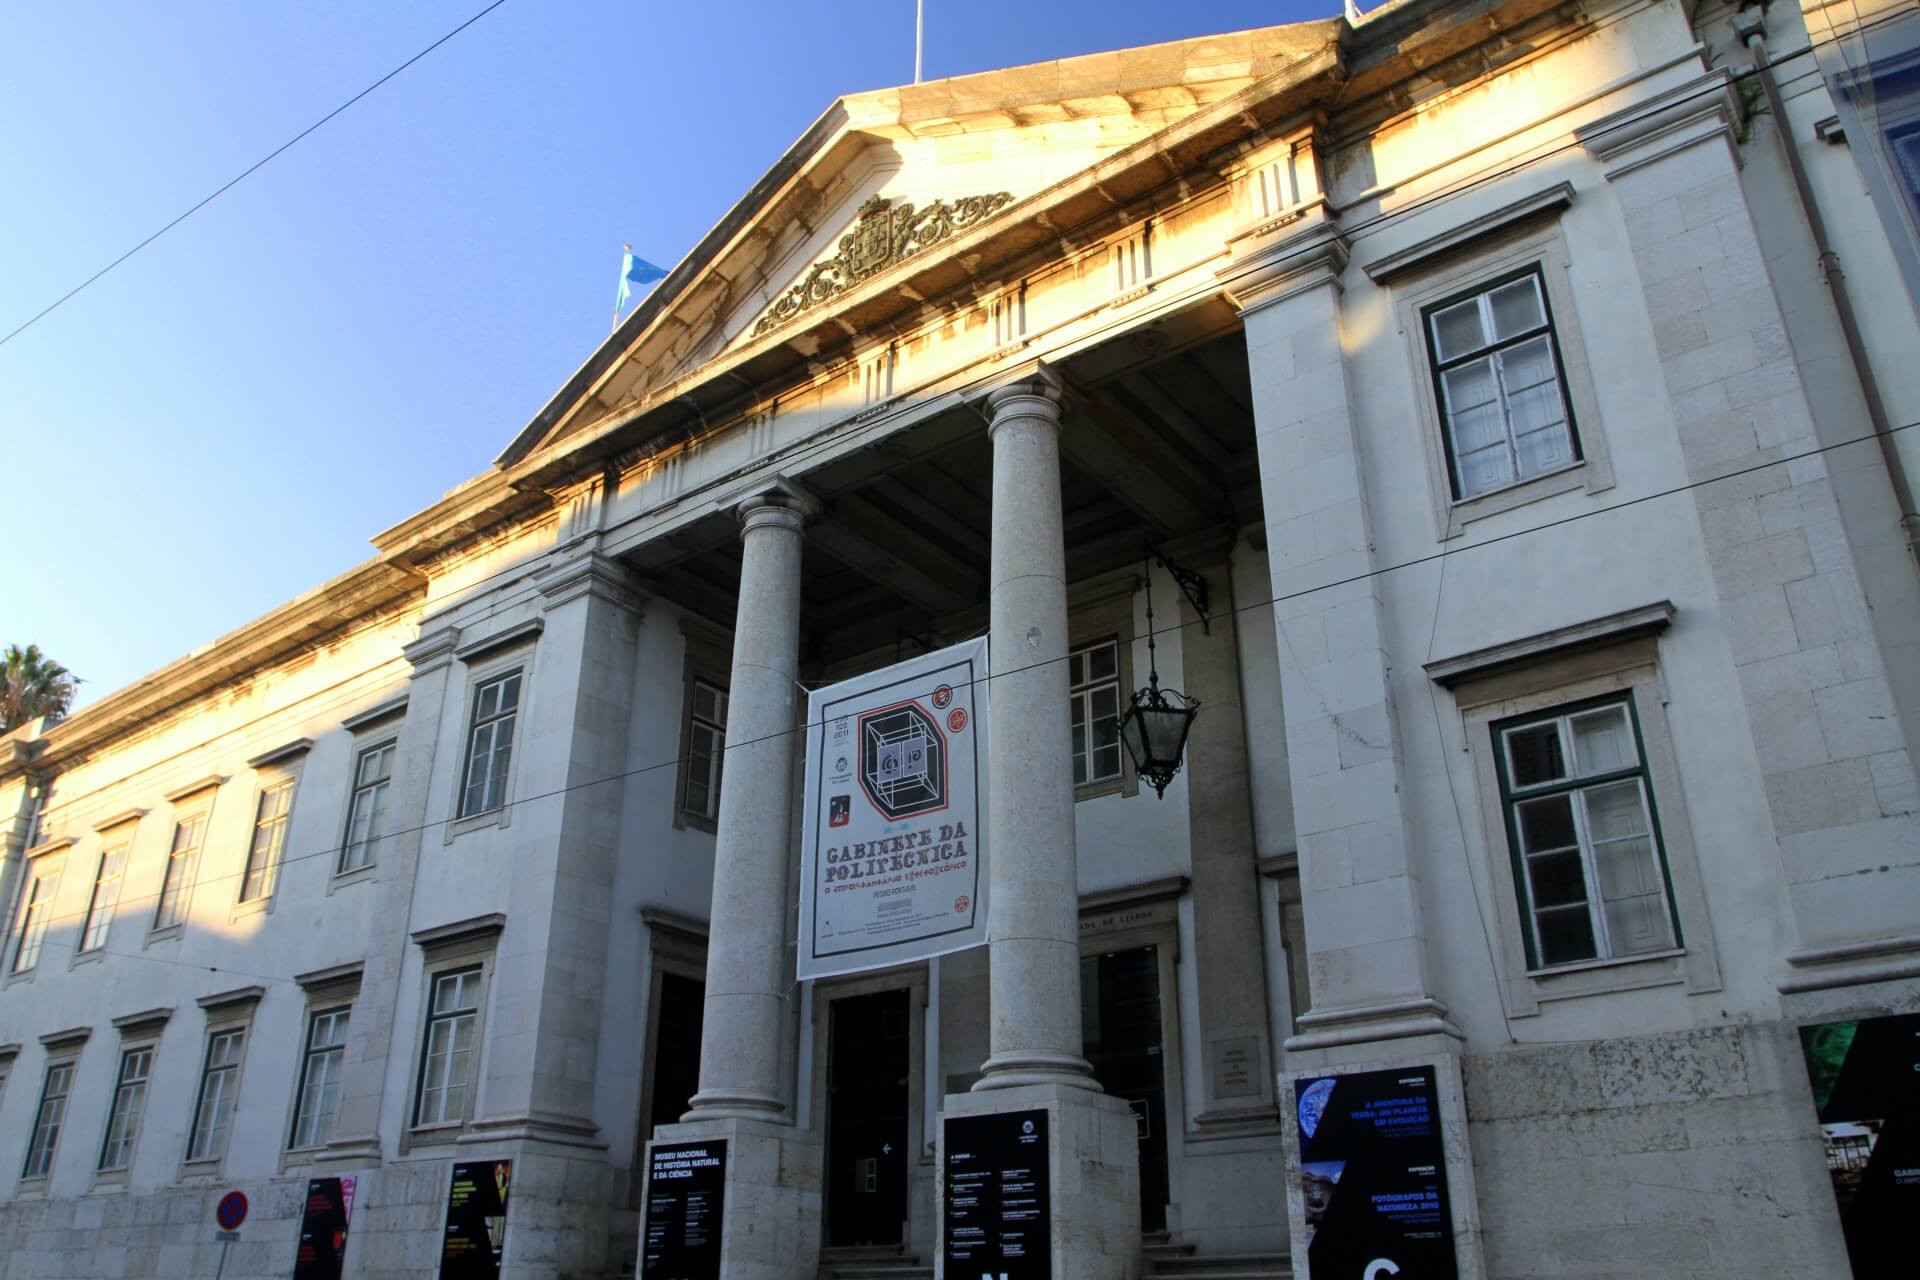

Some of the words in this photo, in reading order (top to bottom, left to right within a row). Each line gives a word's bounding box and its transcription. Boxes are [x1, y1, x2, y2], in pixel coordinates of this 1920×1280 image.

[826, 828, 933, 865] GABINETE
[938, 820, 969, 843] DA
[655, 1152, 676, 1161] MUSEU
[677, 1149, 708, 1159] NACIONAL
[654, 1162, 662, 1170] DE
[692, 1158, 720, 1167] NATURAL
[659, 1171, 668, 1179] DA
